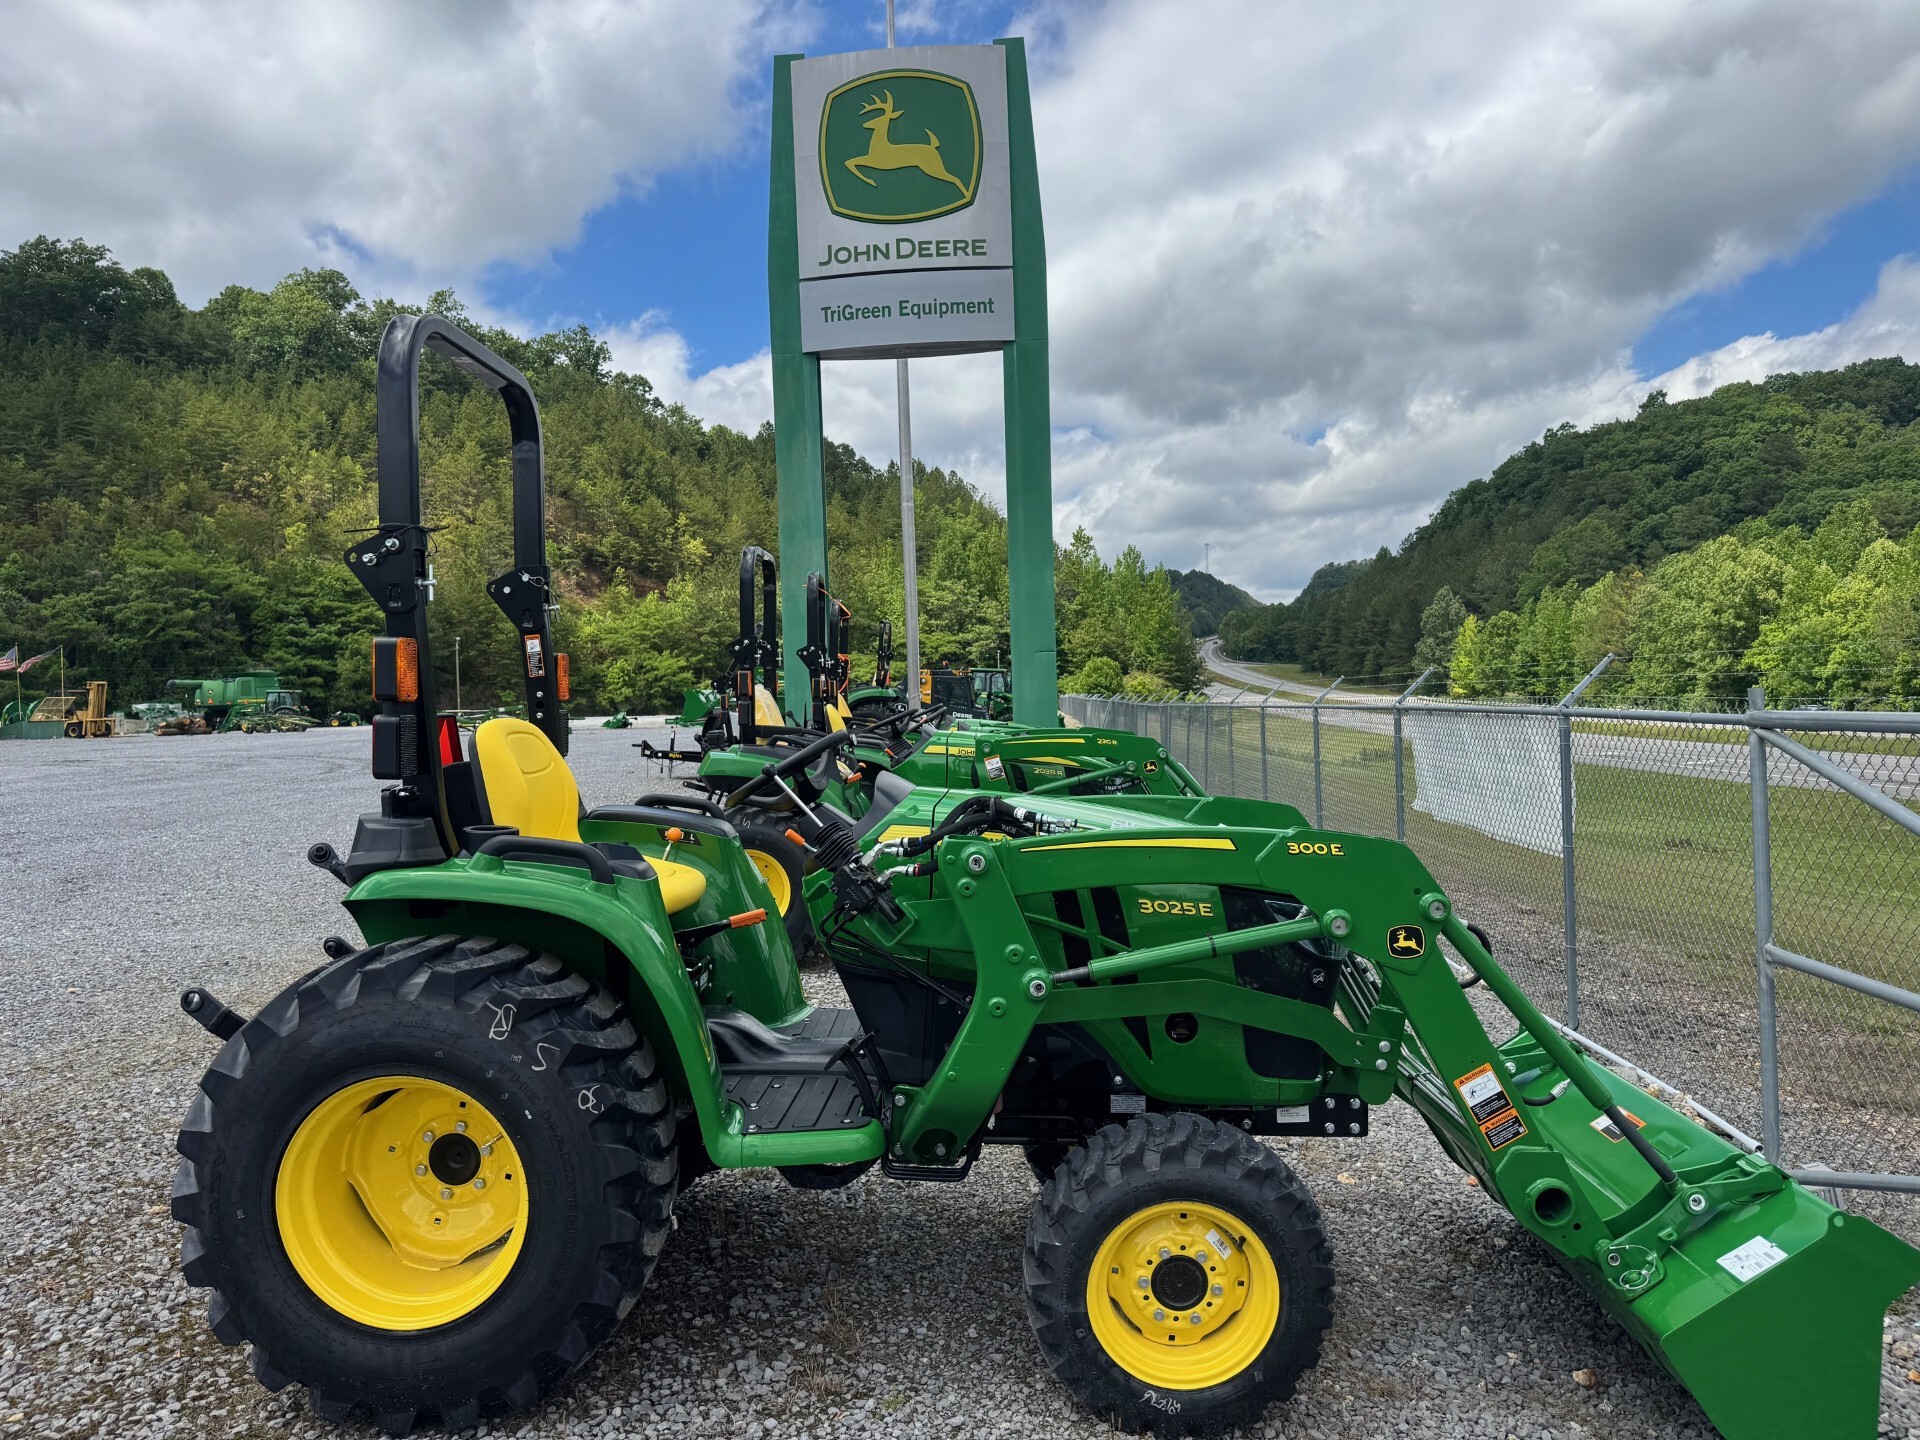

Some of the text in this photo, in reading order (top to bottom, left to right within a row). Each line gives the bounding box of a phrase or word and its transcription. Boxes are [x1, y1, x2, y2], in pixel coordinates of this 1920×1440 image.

[819, 237, 987, 267] JOHN DEERE
[821, 298, 995, 323] TriGreen Equipment
